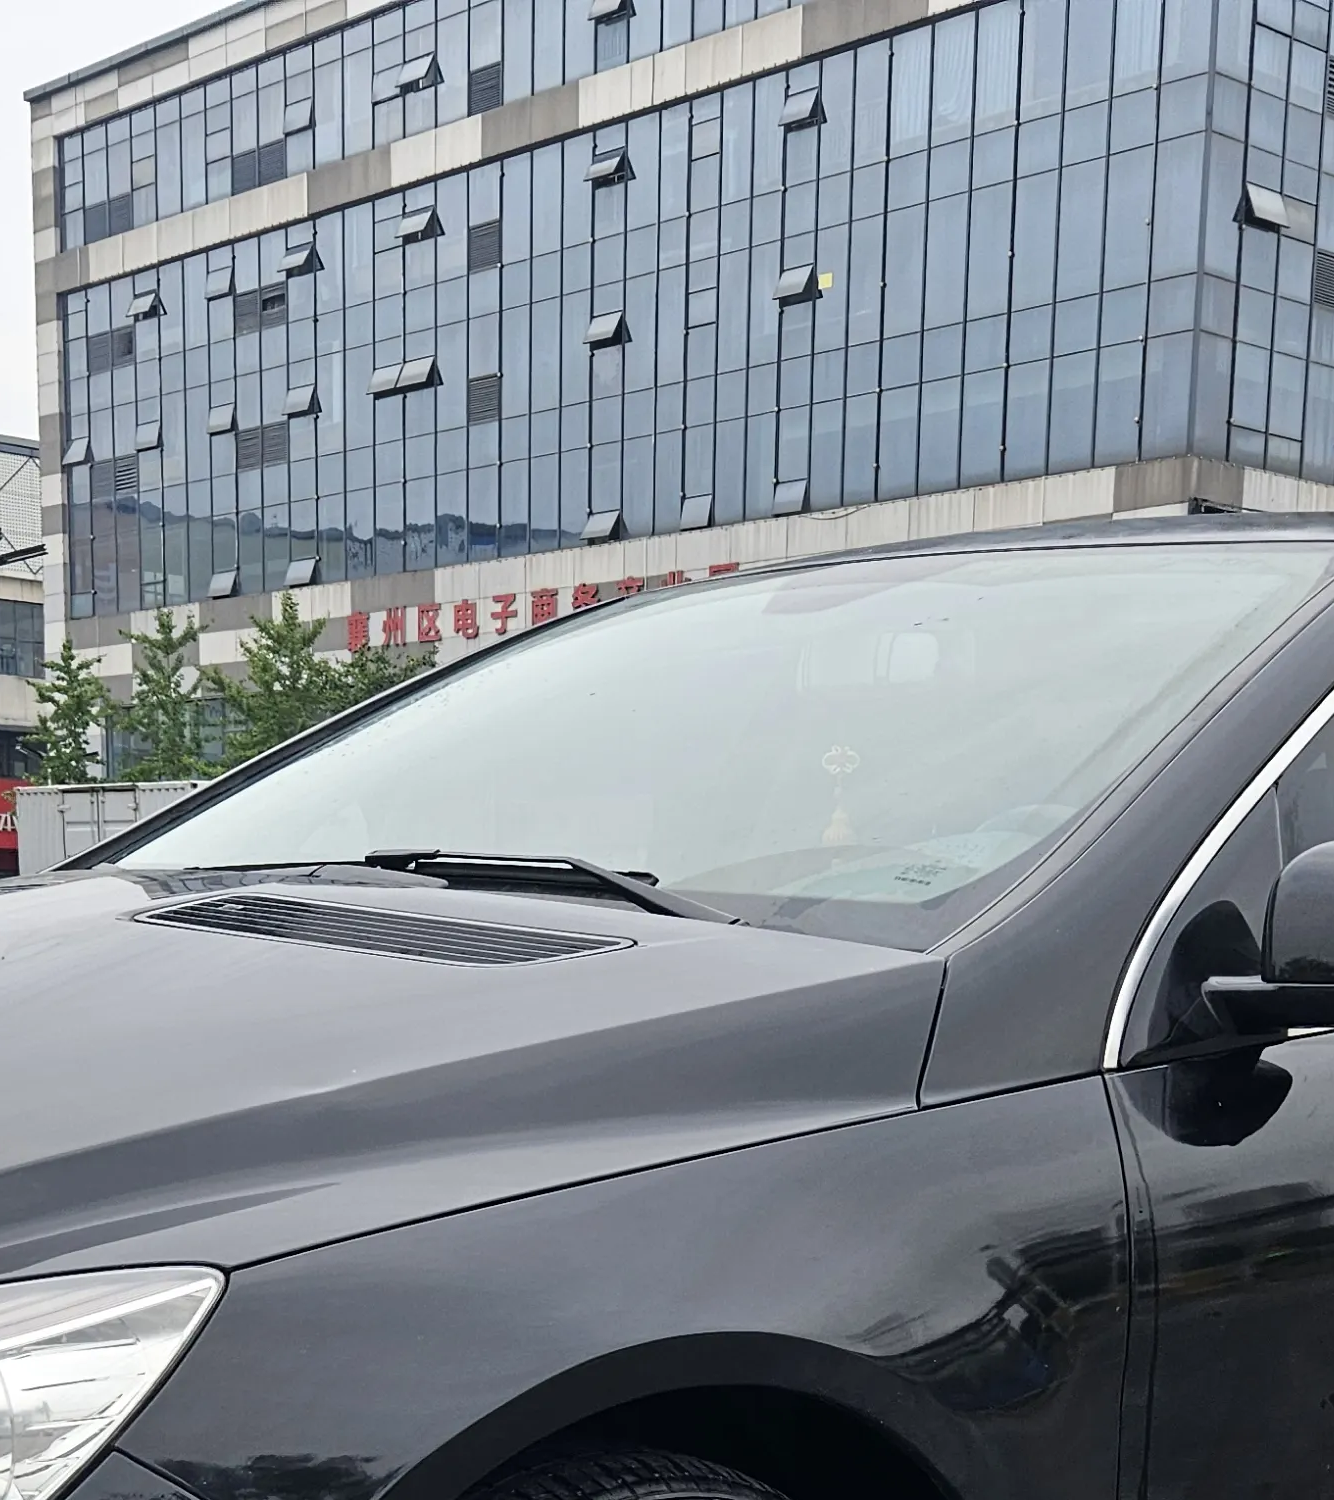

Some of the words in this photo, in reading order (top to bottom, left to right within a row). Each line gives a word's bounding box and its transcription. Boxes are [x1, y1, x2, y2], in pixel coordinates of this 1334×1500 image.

[347, 561, 740, 652] 襄州区电子商务
